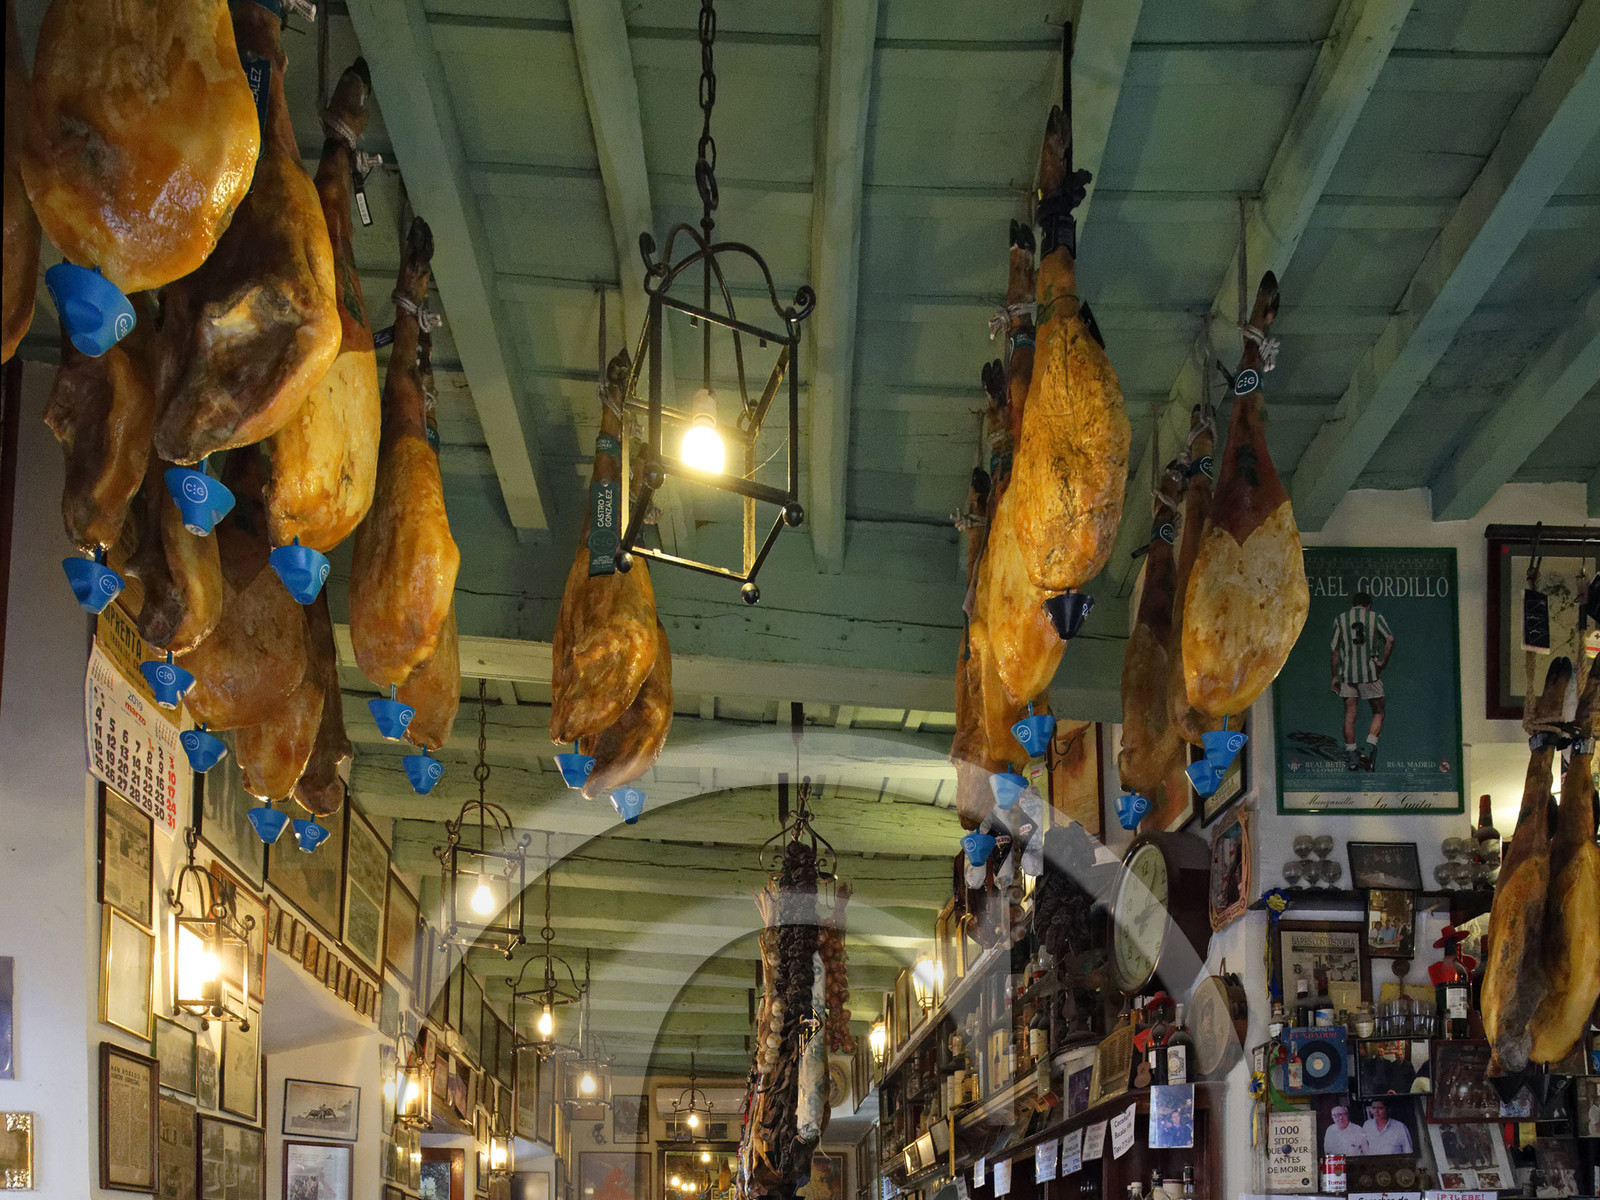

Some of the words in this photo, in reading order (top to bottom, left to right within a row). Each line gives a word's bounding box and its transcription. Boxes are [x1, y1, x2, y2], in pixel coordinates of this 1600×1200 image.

[597, 499, 605, 528] CASTRO
[1357, 576, 1449, 597] GORDILLO
[103, 604, 142, 659] MPRENTA
[1352, 621, 1364, 645] 3
[127, 689, 143, 711] 2019
[125, 702, 147, 726] marzo
[109, 717, 116, 733] 5
[122, 730, 129, 744] 6
[135, 740, 141, 753] 7
[147, 751, 153, 765] 8
[158, 761, 164, 774] 9
[168, 770, 176, 786] 10
[158, 746, 164, 760] 2
[169, 756, 174, 769] 3
[107, 734, 116, 751] 12
[120, 745, 129, 761] 13
[132, 755, 141, 772] 14
[145, 766, 153, 781] 15
[156, 776, 165, 791] 16
[168, 785, 176, 799] 17
[106, 750, 116, 766] 19
[118, 758, 129, 777] 20
[132, 770, 140, 787] 21
[143, 780, 153, 797] 22
[166, 798, 176, 816] 24
[105, 764, 115, 783] 26
[118, 774, 128, 792] 27
[130, 785, 140, 803] 28
[142, 794, 152, 812] 29
[154, 803, 165, 821] 30
[168, 813, 176, 830] 31
[1274, 1137, 1299, 1145] SITIOS
[1274, 1156, 1301, 1164] ANTES
[1280, 1165, 1307, 1174] MORIR
